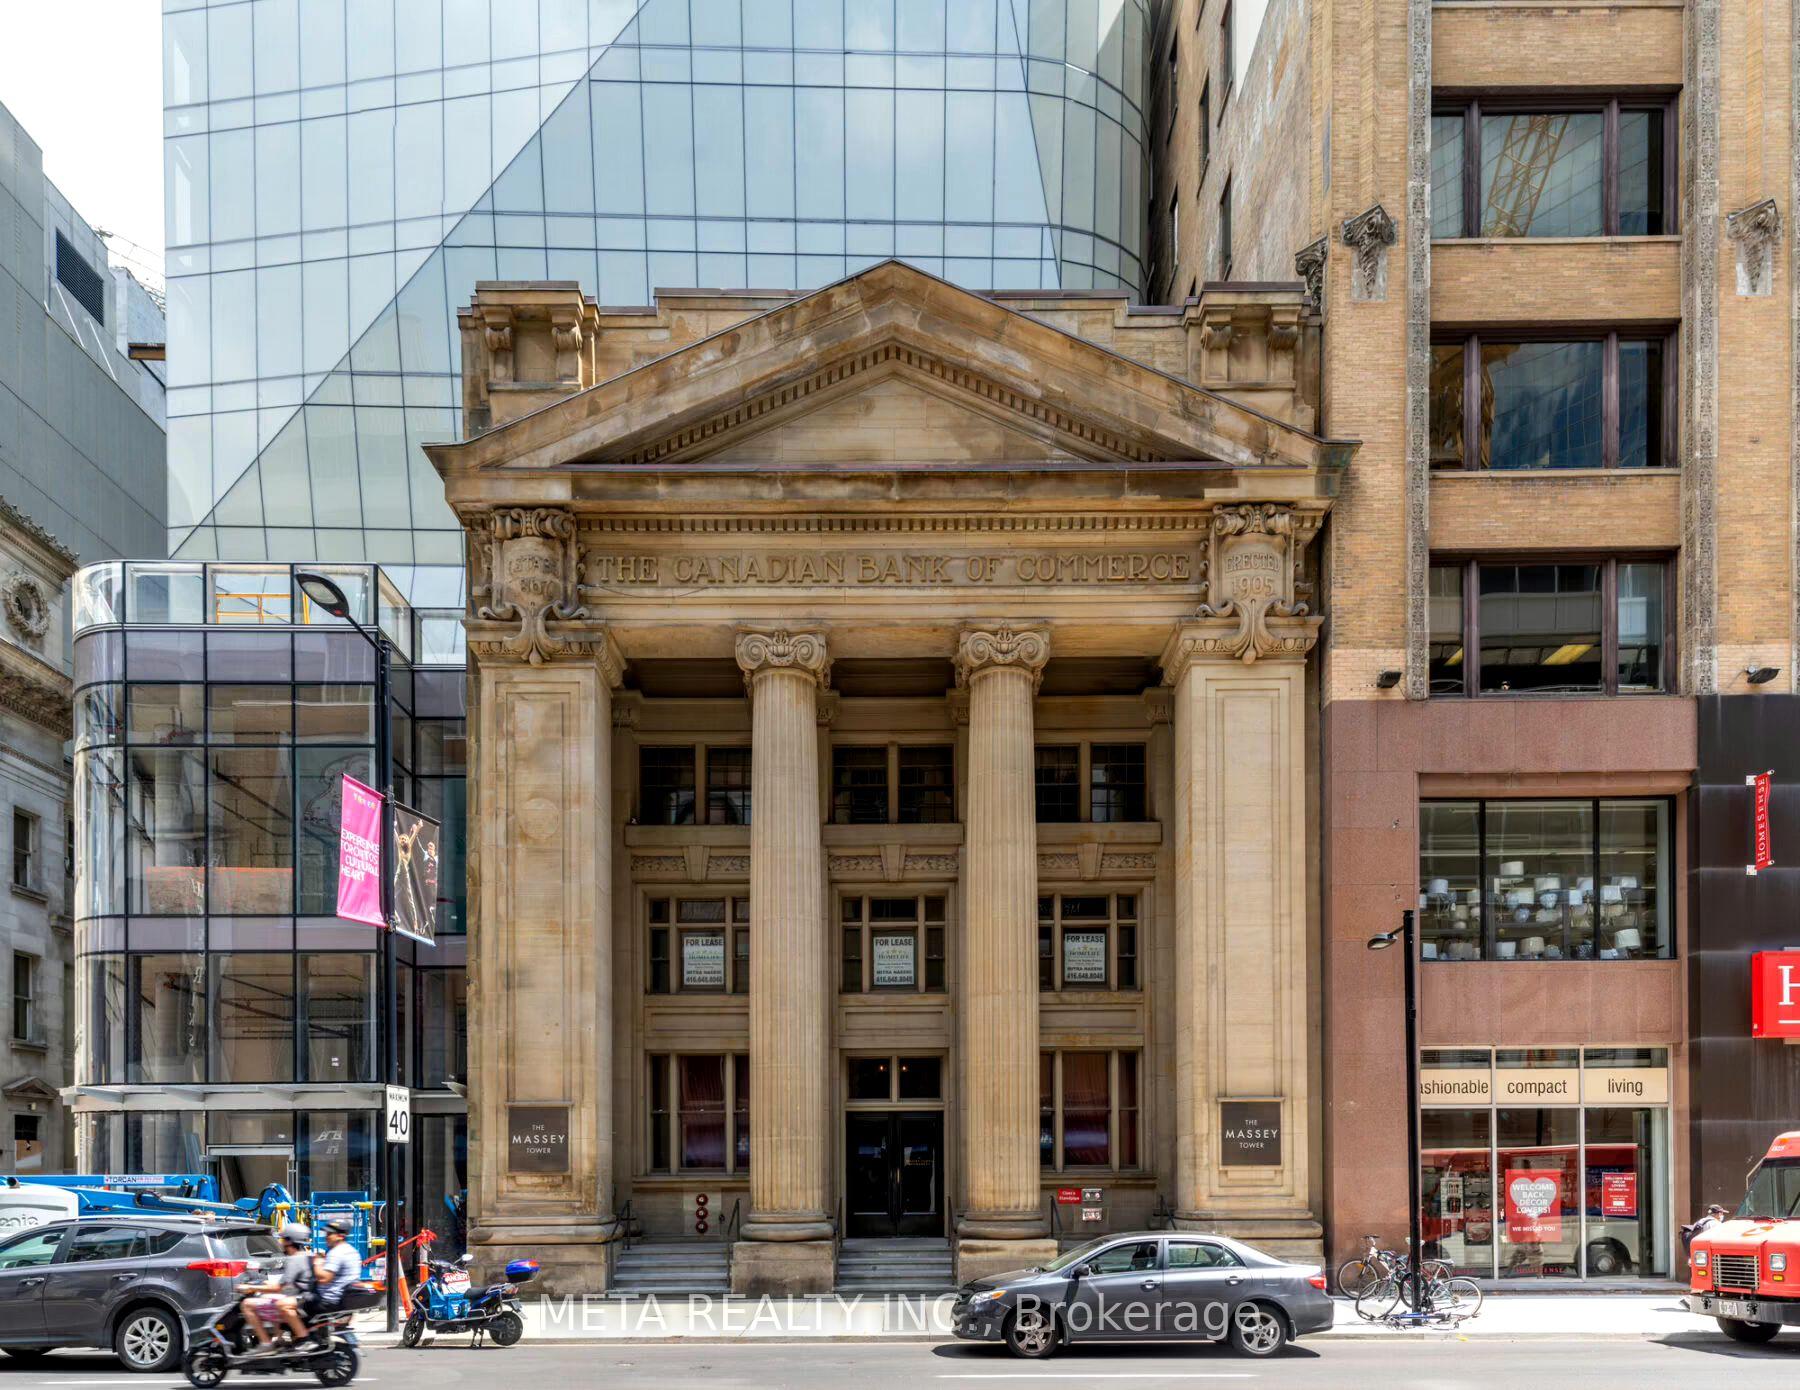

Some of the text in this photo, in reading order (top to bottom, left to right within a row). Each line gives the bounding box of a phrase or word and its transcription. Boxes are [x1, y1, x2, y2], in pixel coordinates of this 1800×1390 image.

[597, 554, 1191, 583] THE CANADIAN BANK OF COMMERCE
[1225, 552, 1280, 573] ERECTED
[1231, 576, 1274, 600] 1905
[341, 864, 366, 881] HEART
[1507, 1079, 1567, 1096] compact
[1608, 1078, 1643, 1096] living
[389, 1110, 408, 1135] 40
[512, 1135, 565, 1144] MASSEY
[1225, 1130, 1278, 1139] MASSEY
